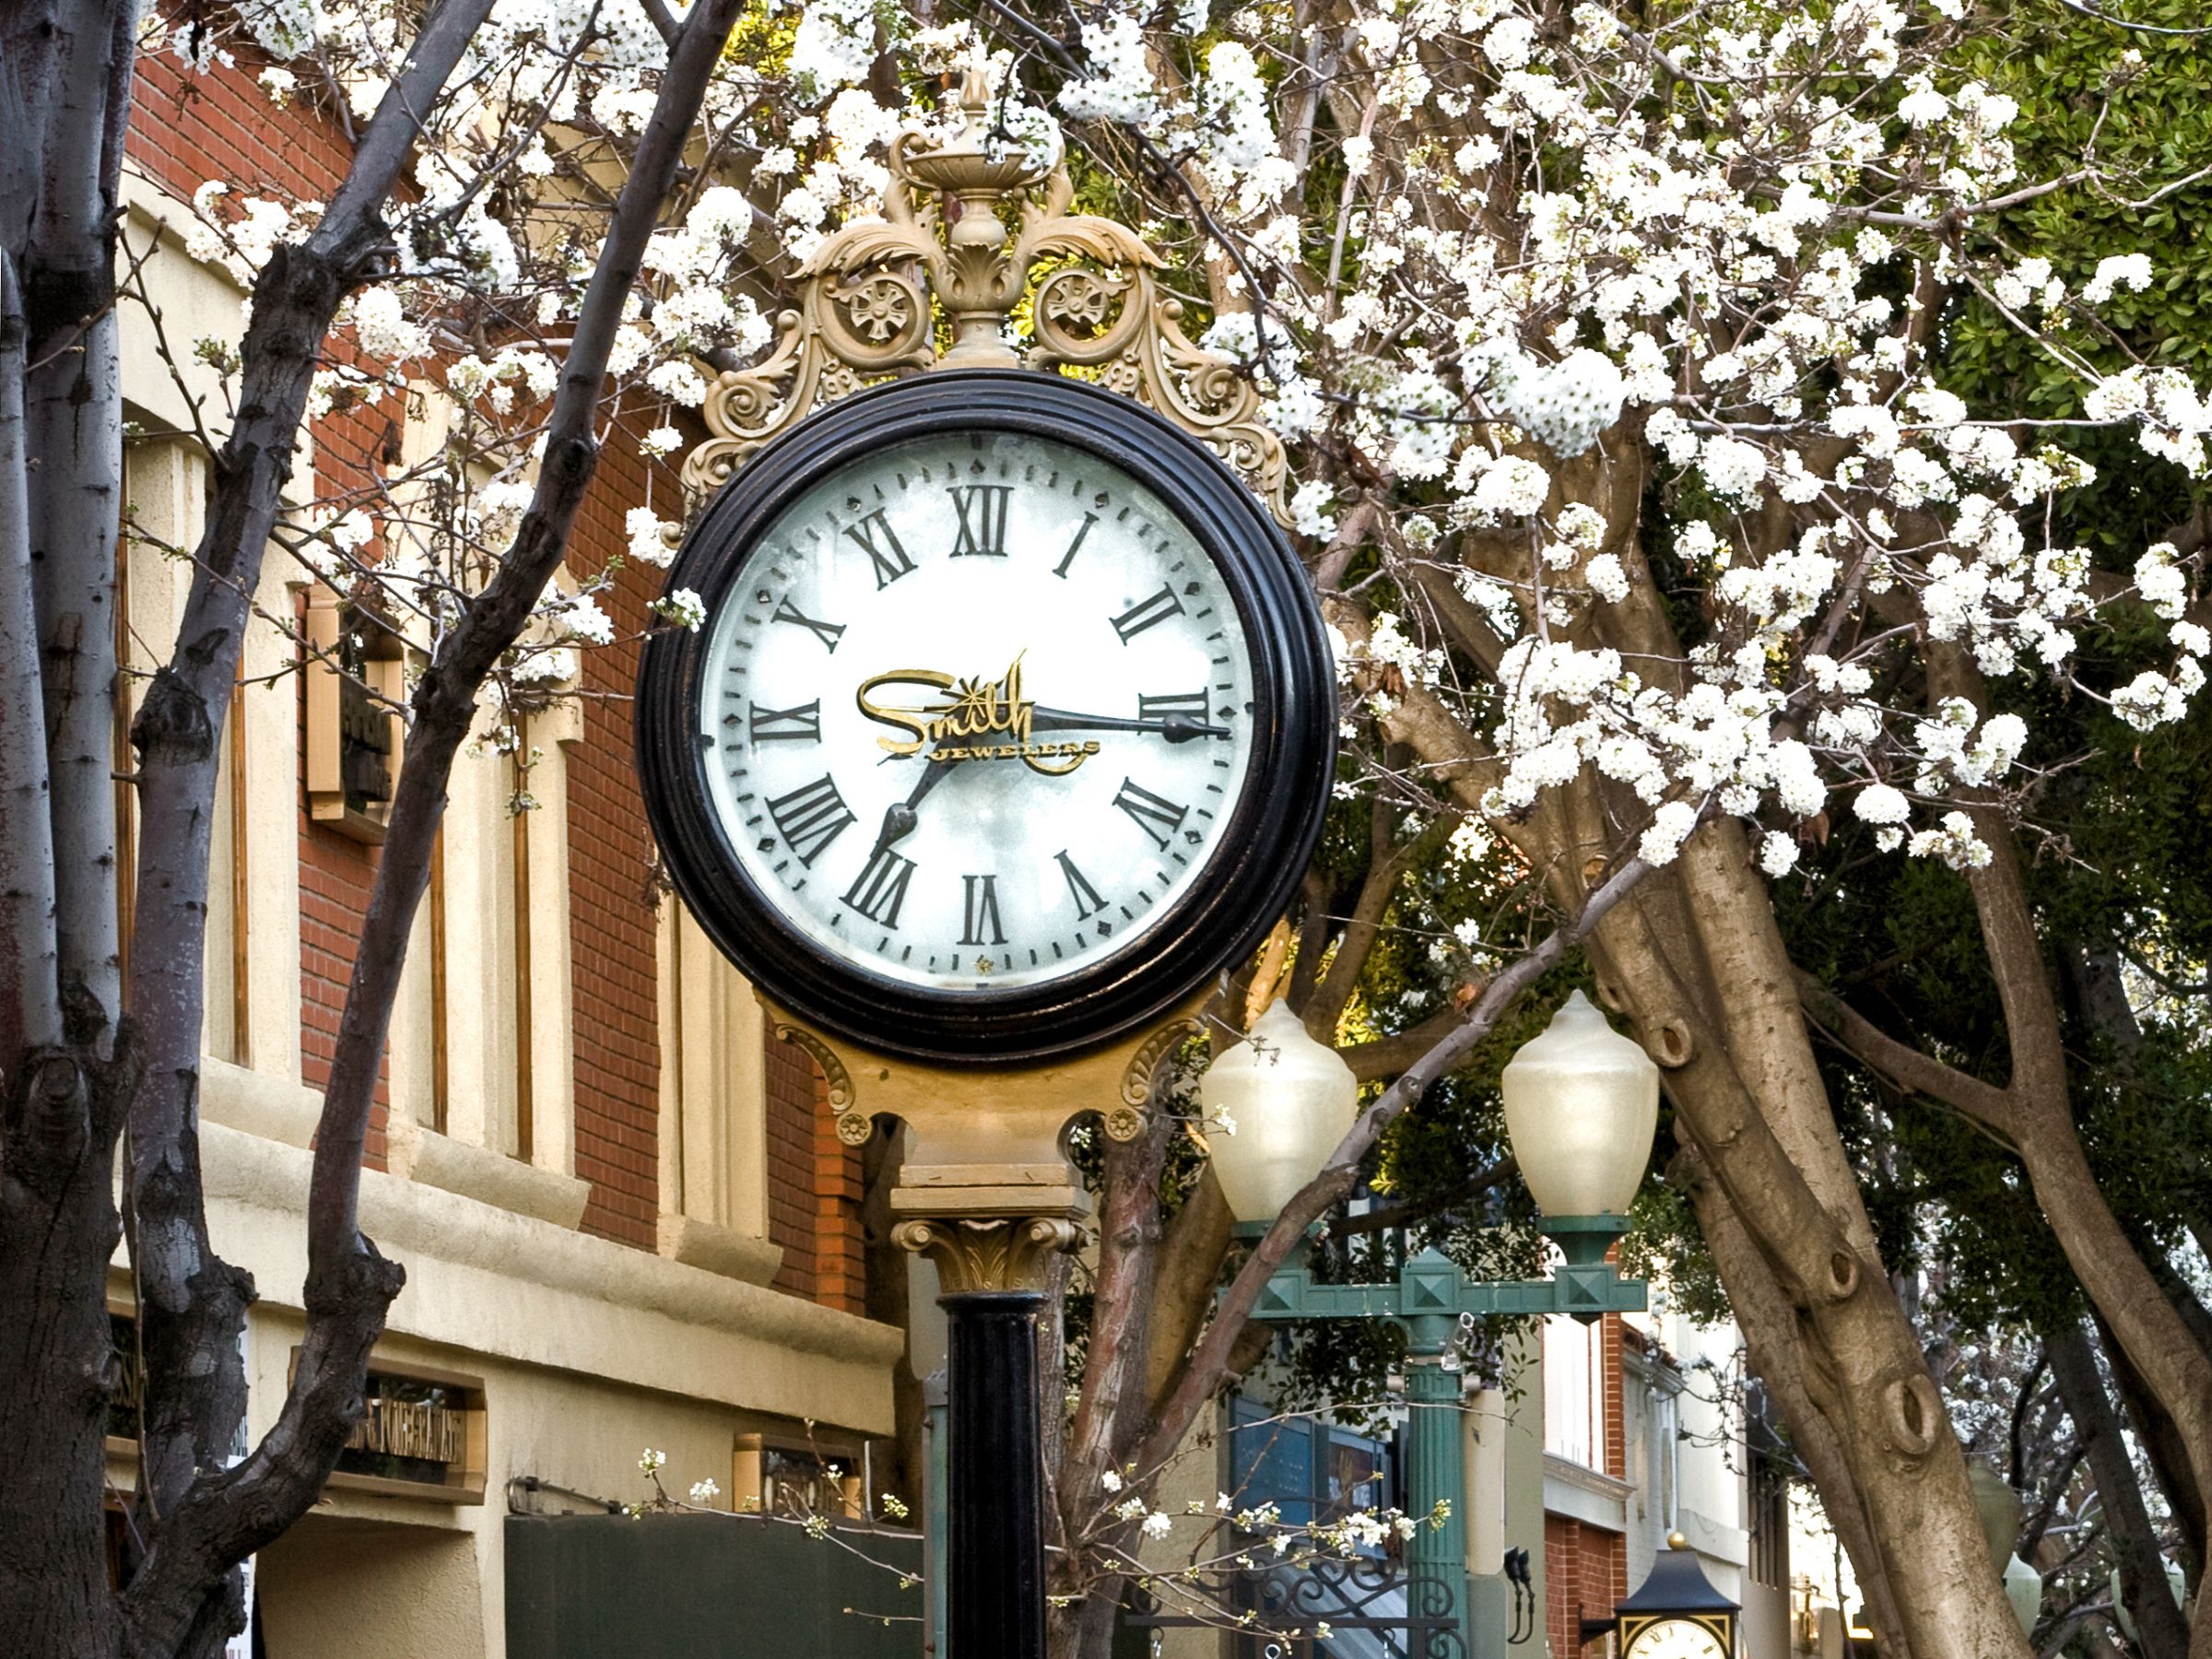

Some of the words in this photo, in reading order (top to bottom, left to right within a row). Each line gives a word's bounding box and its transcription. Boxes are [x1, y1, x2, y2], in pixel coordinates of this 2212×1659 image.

[841, 508, 918, 591] XI
[946, 485, 1015, 558] XII
[1052, 511, 1100, 580] I
[771, 593, 847, 654] X
[1109, 582, 1186, 647] II
[749, 698, 821, 746] IX
[856, 648, 1034, 756] Smith
[1137, 687, 1209, 740] II
[928, 740, 1100, 763] JEWELERS
[764, 772, 858, 870] VIII
[1112, 776, 1189, 852] IV
[839, 841, 918, 930] VII
[957, 875, 1008, 946] VI
[1053, 849, 1110, 921] V
